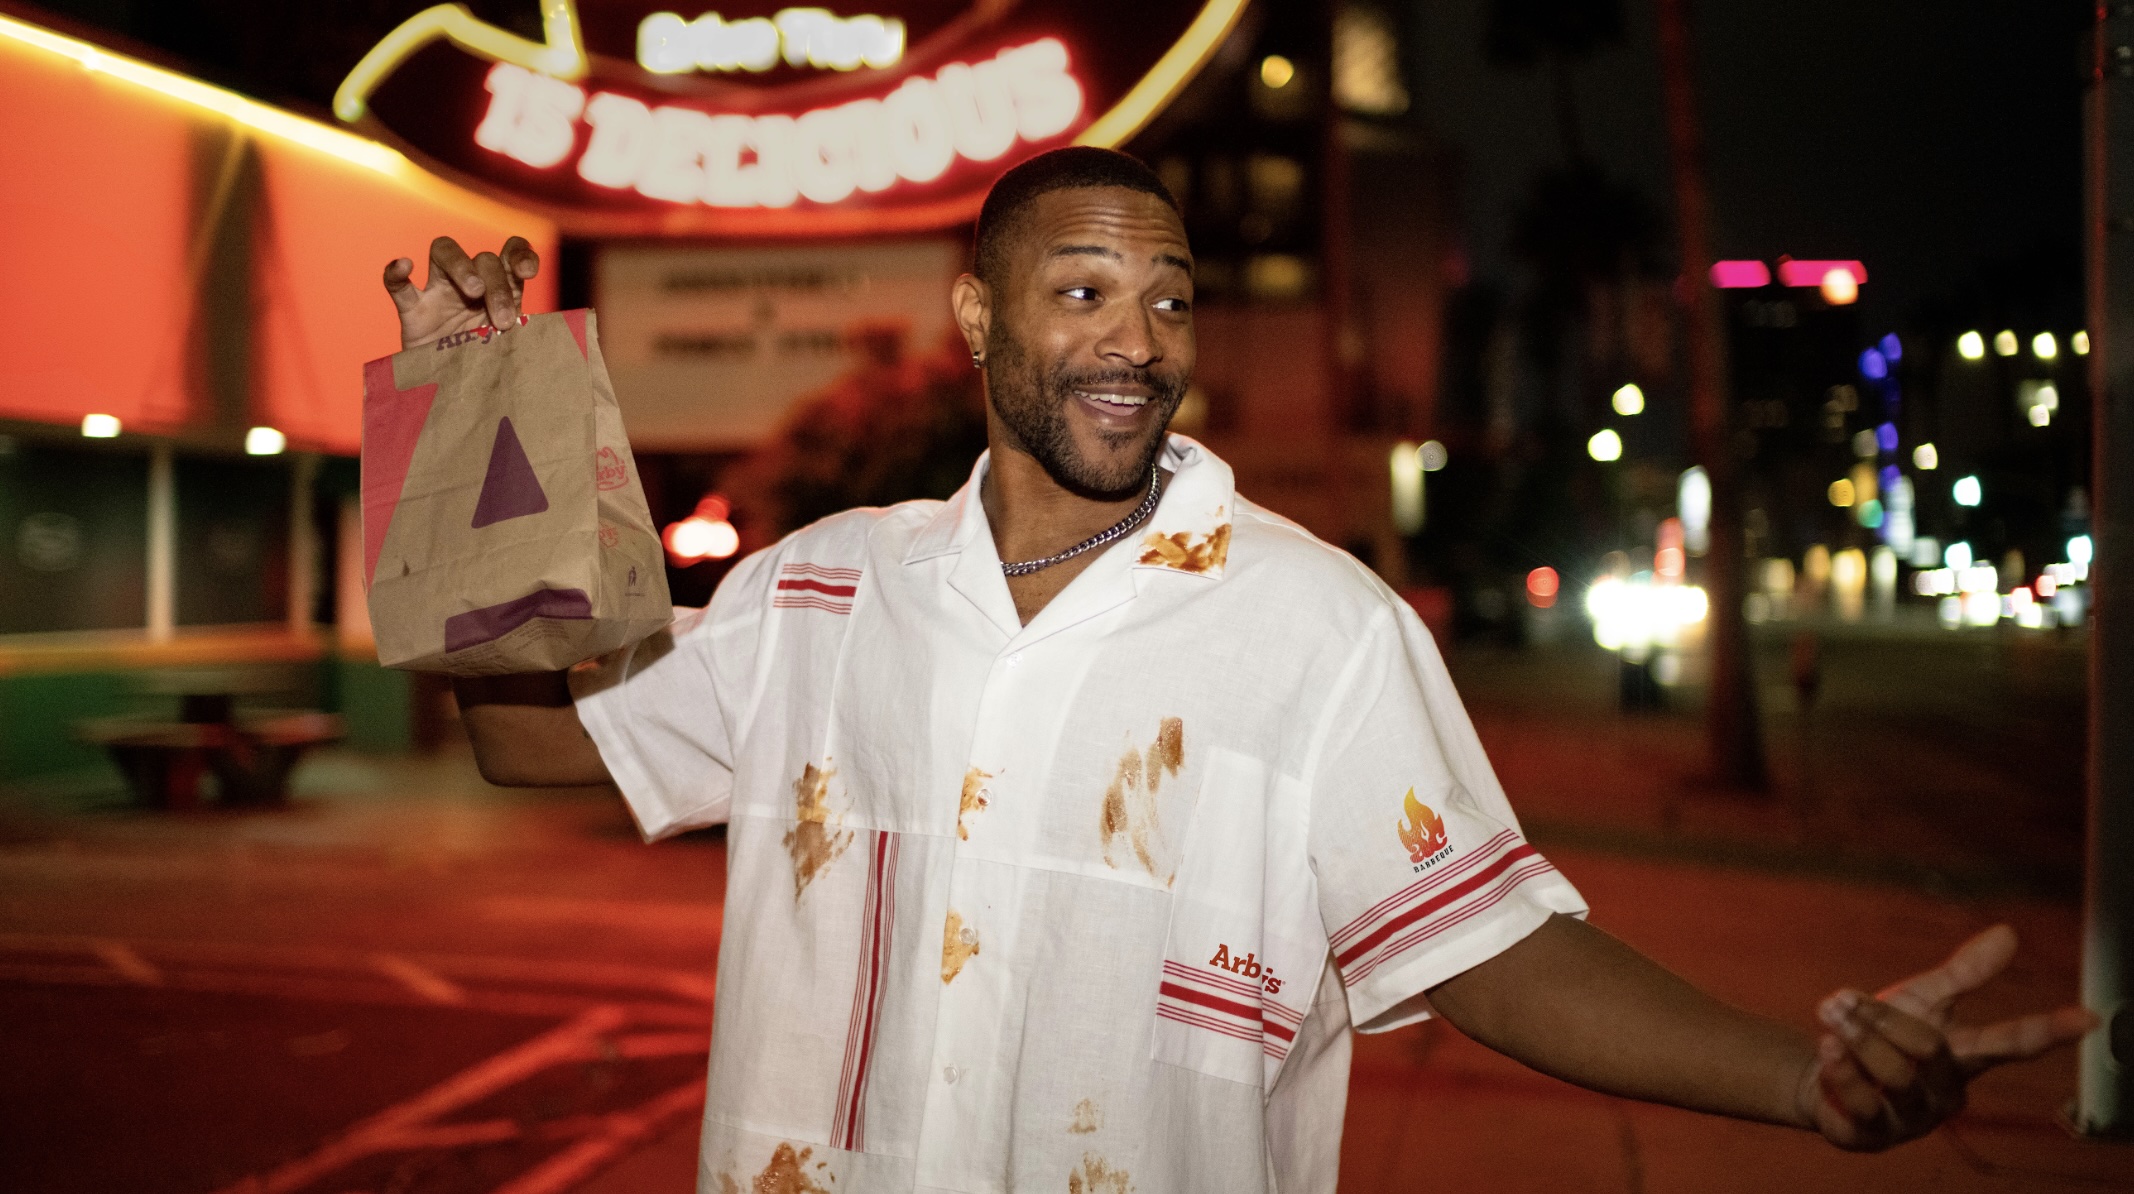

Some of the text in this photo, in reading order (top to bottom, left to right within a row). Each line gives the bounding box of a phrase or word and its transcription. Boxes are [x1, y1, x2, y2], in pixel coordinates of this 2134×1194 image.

[476, 37, 1084, 207] IS DELICIOUS
[1413, 844, 1455, 873] BARBEQUE
